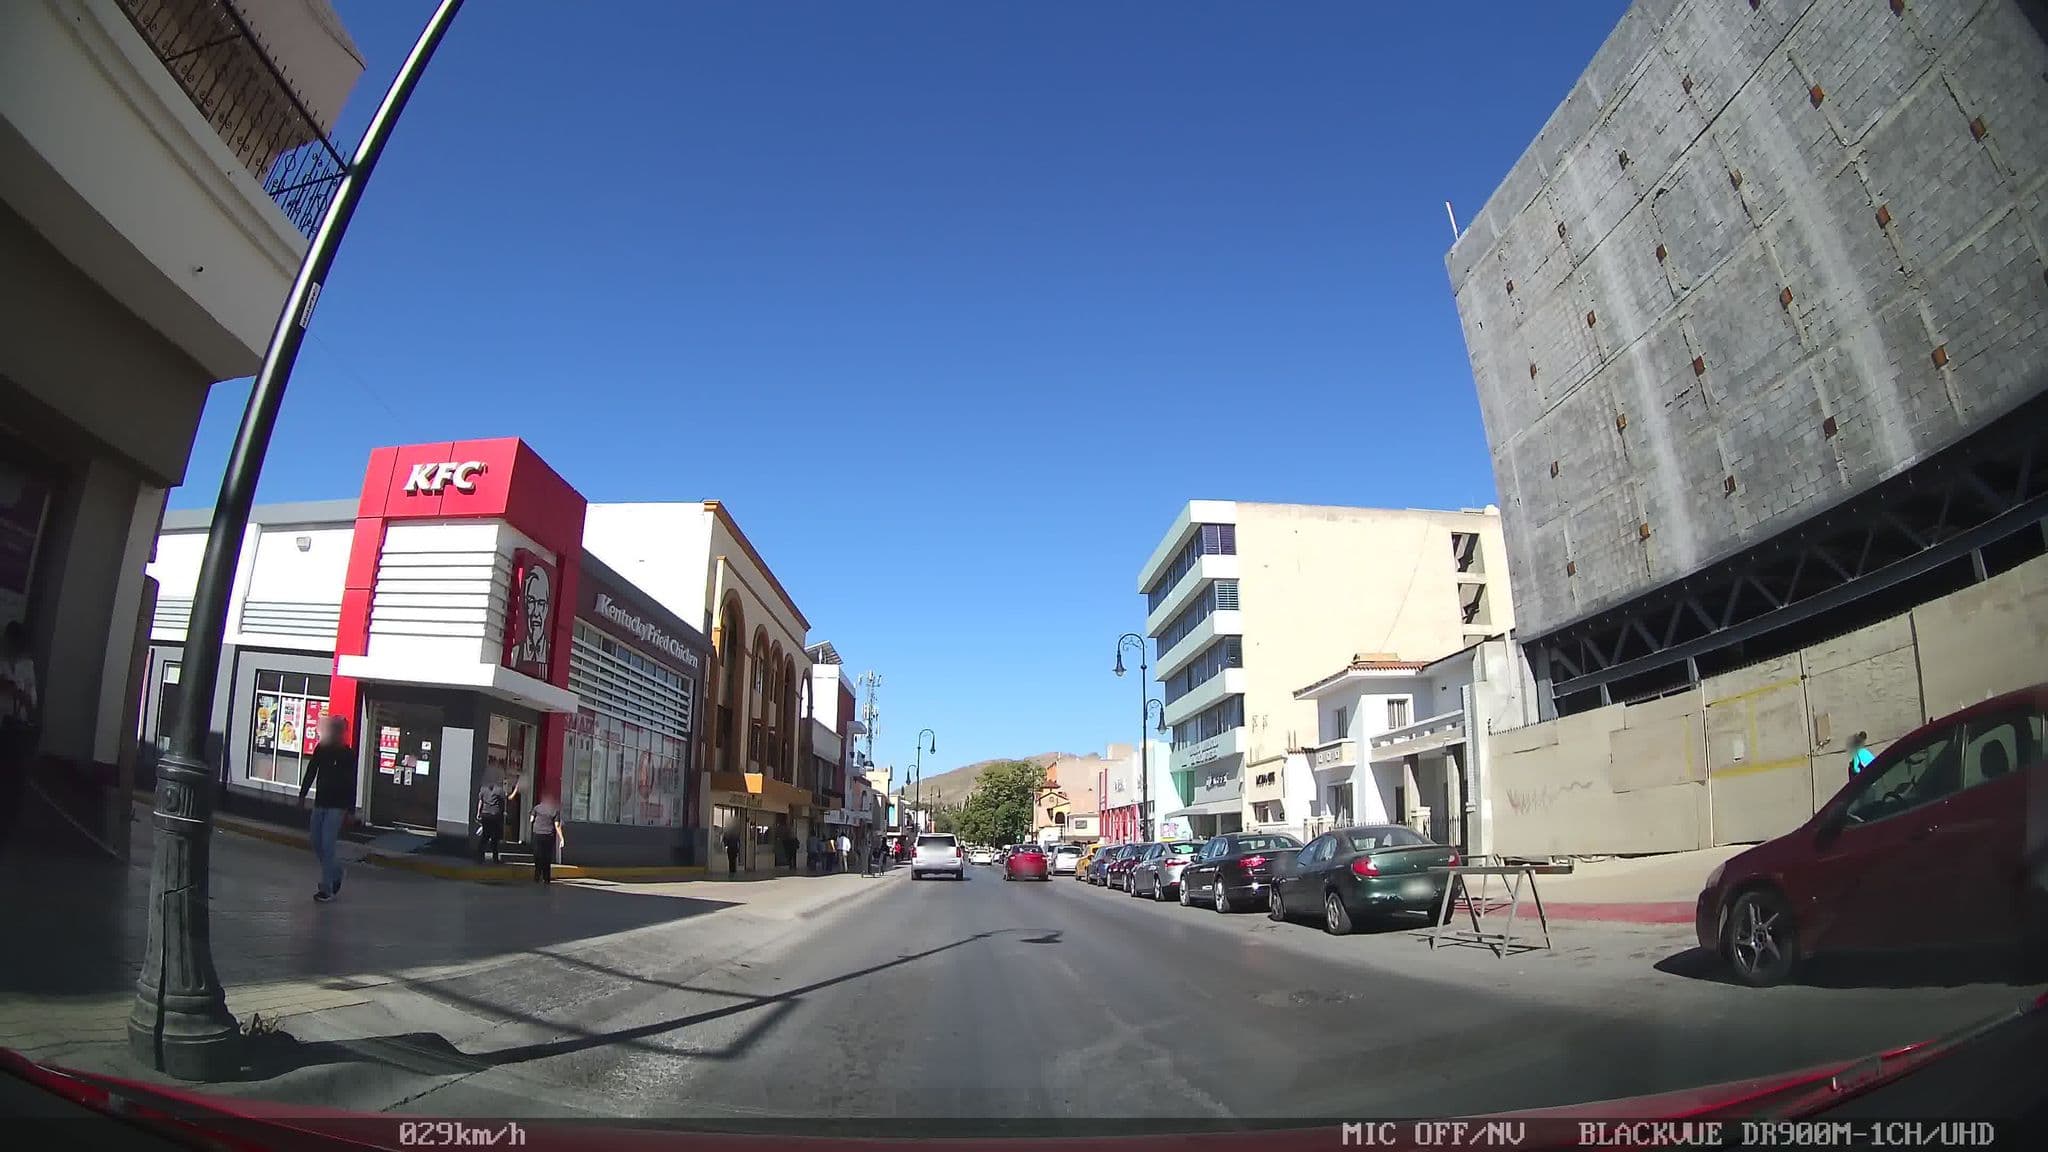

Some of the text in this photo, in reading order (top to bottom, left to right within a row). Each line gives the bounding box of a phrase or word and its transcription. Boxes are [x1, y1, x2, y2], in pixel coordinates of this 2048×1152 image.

[403, 461, 486, 494] KFC
[594, 593, 698, 669] Kentucky Fried Chicken
